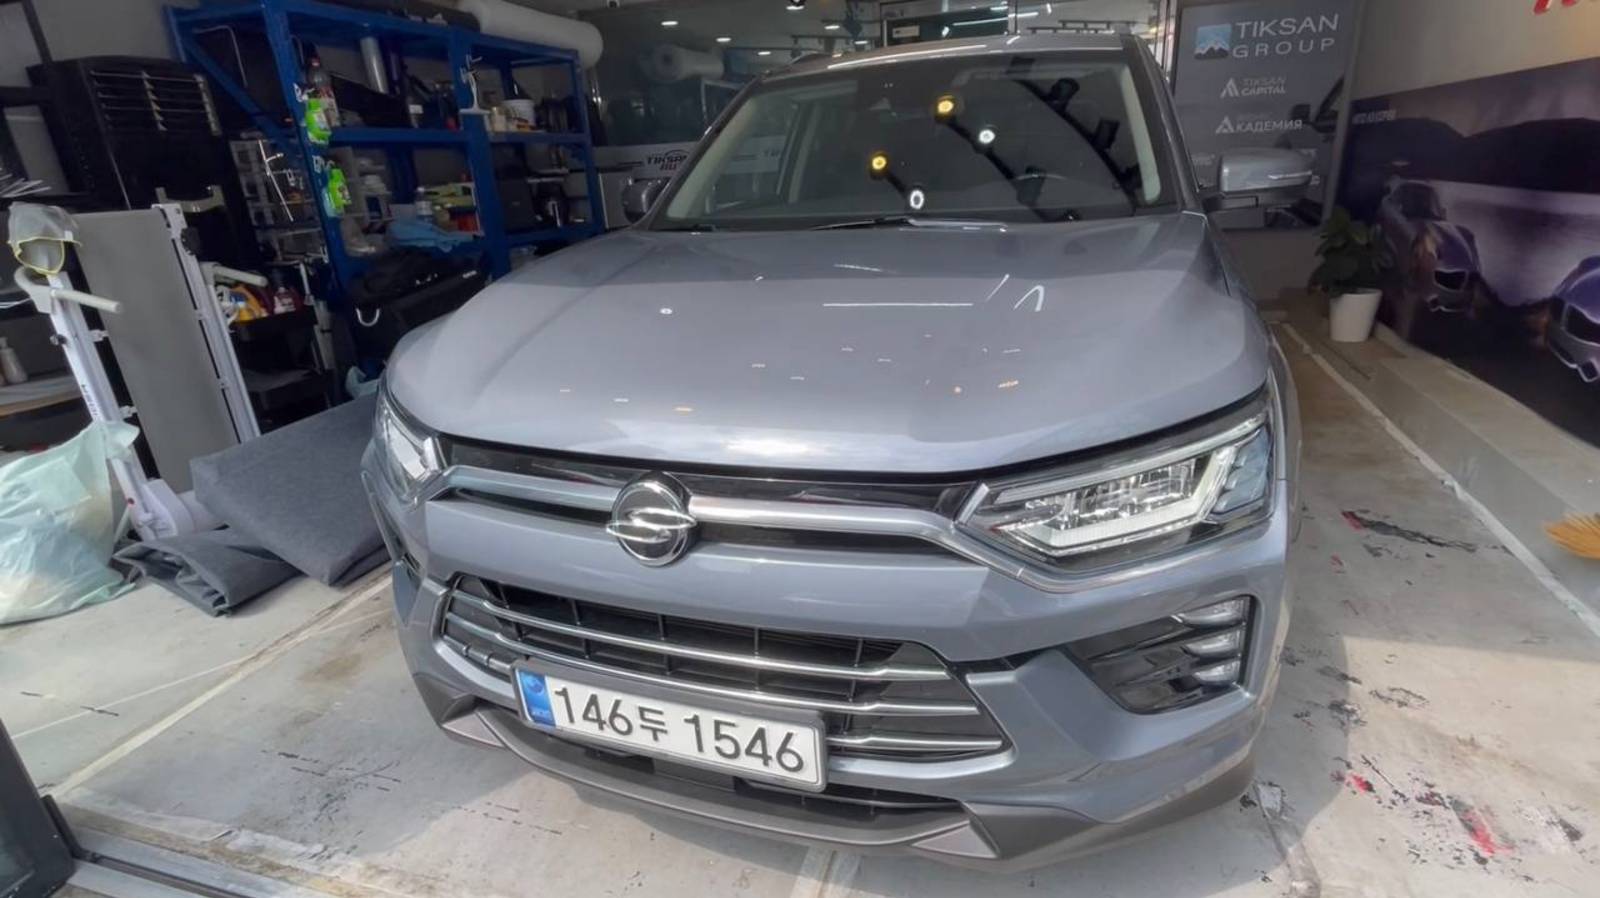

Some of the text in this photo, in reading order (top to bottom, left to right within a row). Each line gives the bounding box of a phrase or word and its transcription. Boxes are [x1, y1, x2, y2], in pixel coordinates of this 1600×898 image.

[1235, 12, 1339, 39] TIKSAN
[1232, 37, 1336, 59] GROUP
[1241, 85, 1287, 97] CAPITAL
[554, 687, 804, 772] 146두 1546
